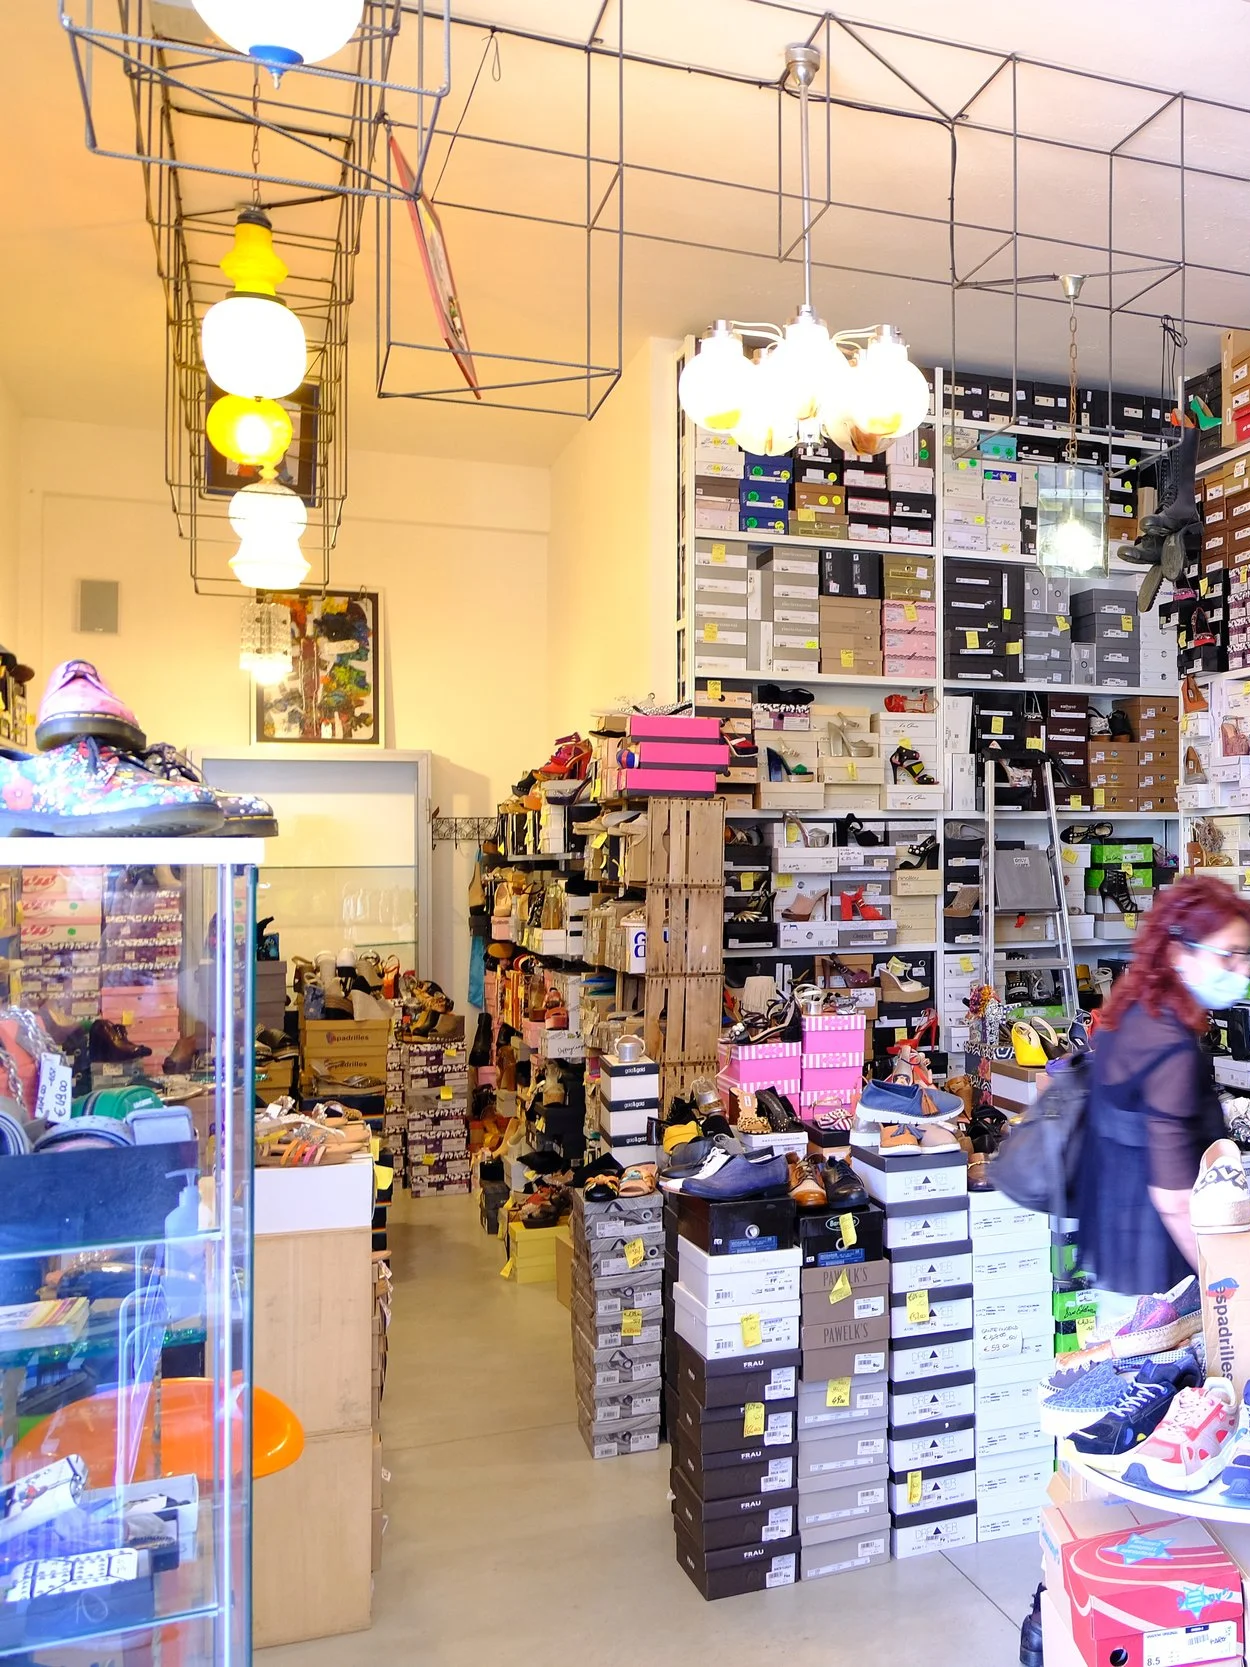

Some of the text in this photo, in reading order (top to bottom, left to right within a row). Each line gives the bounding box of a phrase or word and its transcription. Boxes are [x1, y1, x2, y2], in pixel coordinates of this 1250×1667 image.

[823, 1266, 868, 1286] PAWLK'S
[823, 1321, 869, 1344] PAWELK'S
[743, 1360, 764, 1368] FRAU
[741, 1451, 762, 1459] FRAU
[741, 1501, 762, 1509] FRAU
[743, 1549, 764, 1558] FRAU
[1147, 1656, 1160, 1667] 8.5
